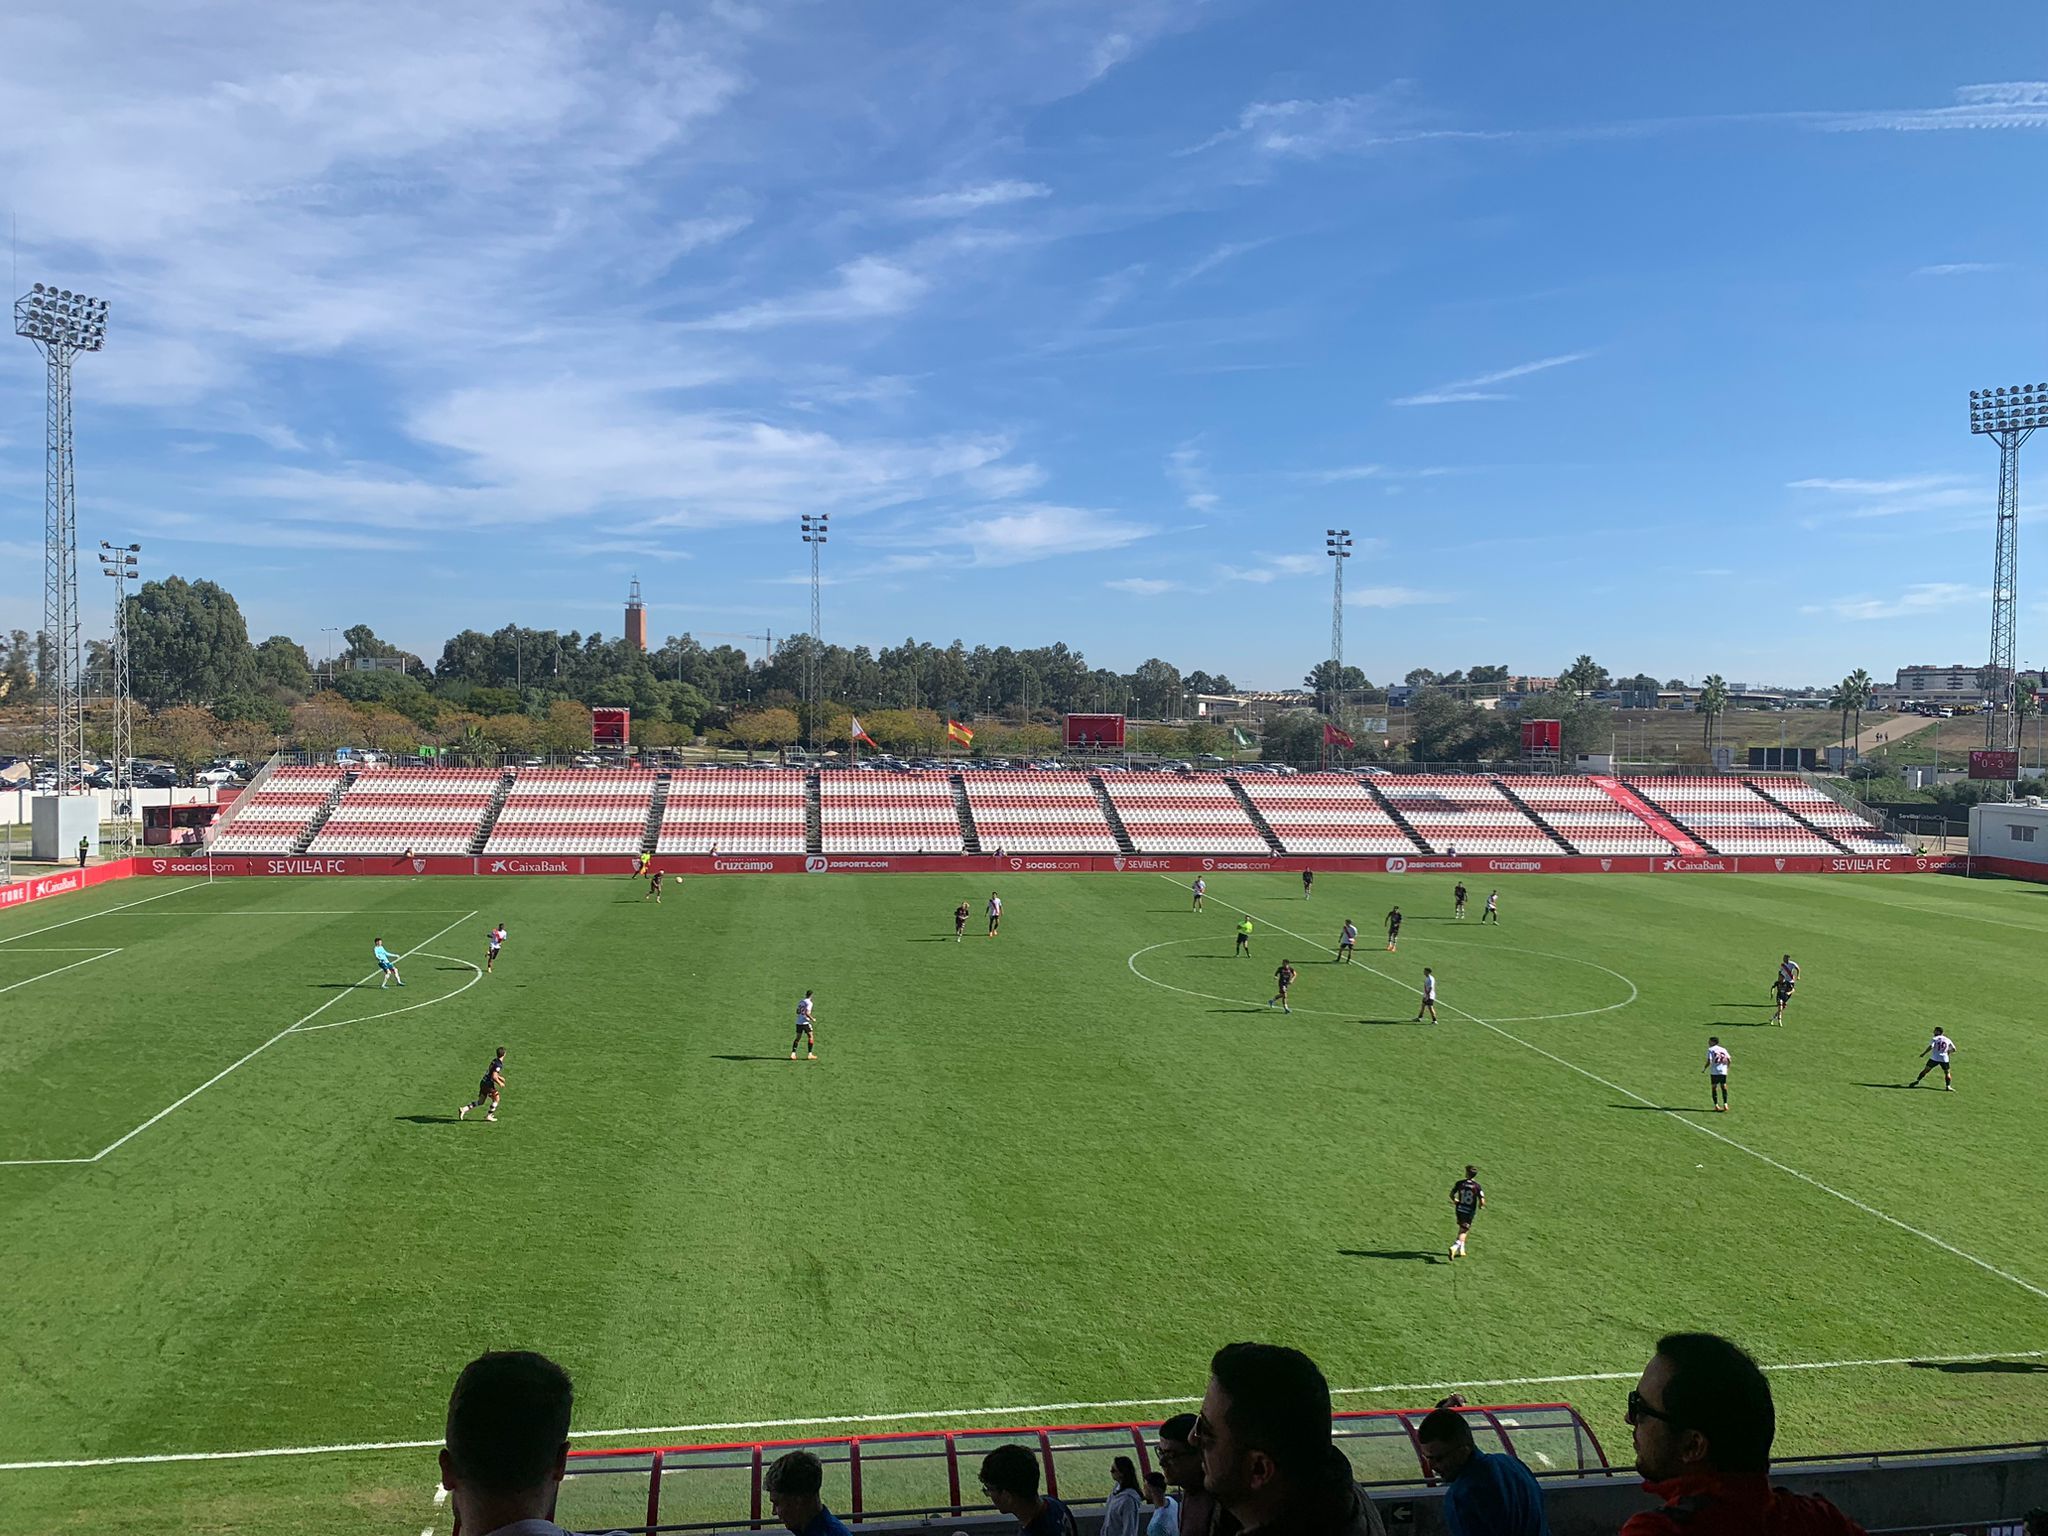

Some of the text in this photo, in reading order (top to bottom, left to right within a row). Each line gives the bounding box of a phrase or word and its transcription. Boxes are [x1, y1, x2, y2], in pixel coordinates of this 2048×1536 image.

[267, 860, 345, 874] SEVILLA FC
[508, 860, 568, 872] CaixaBank
[714, 860, 773, 872] Cruzcampo
[1128, 860, 1170, 869] SEVILLA FC
[1407, 861, 1463, 869] JDSPORTS.COM
[1489, 860, 1541, 871] Cruzcampo
[1677, 860, 1725, 871] CaixaBank
[1832, 859, 1891, 871] SEVILLA FC
[0, 887, 24, 904] TORE
[1460, 1189, 1474, 1205] 18
